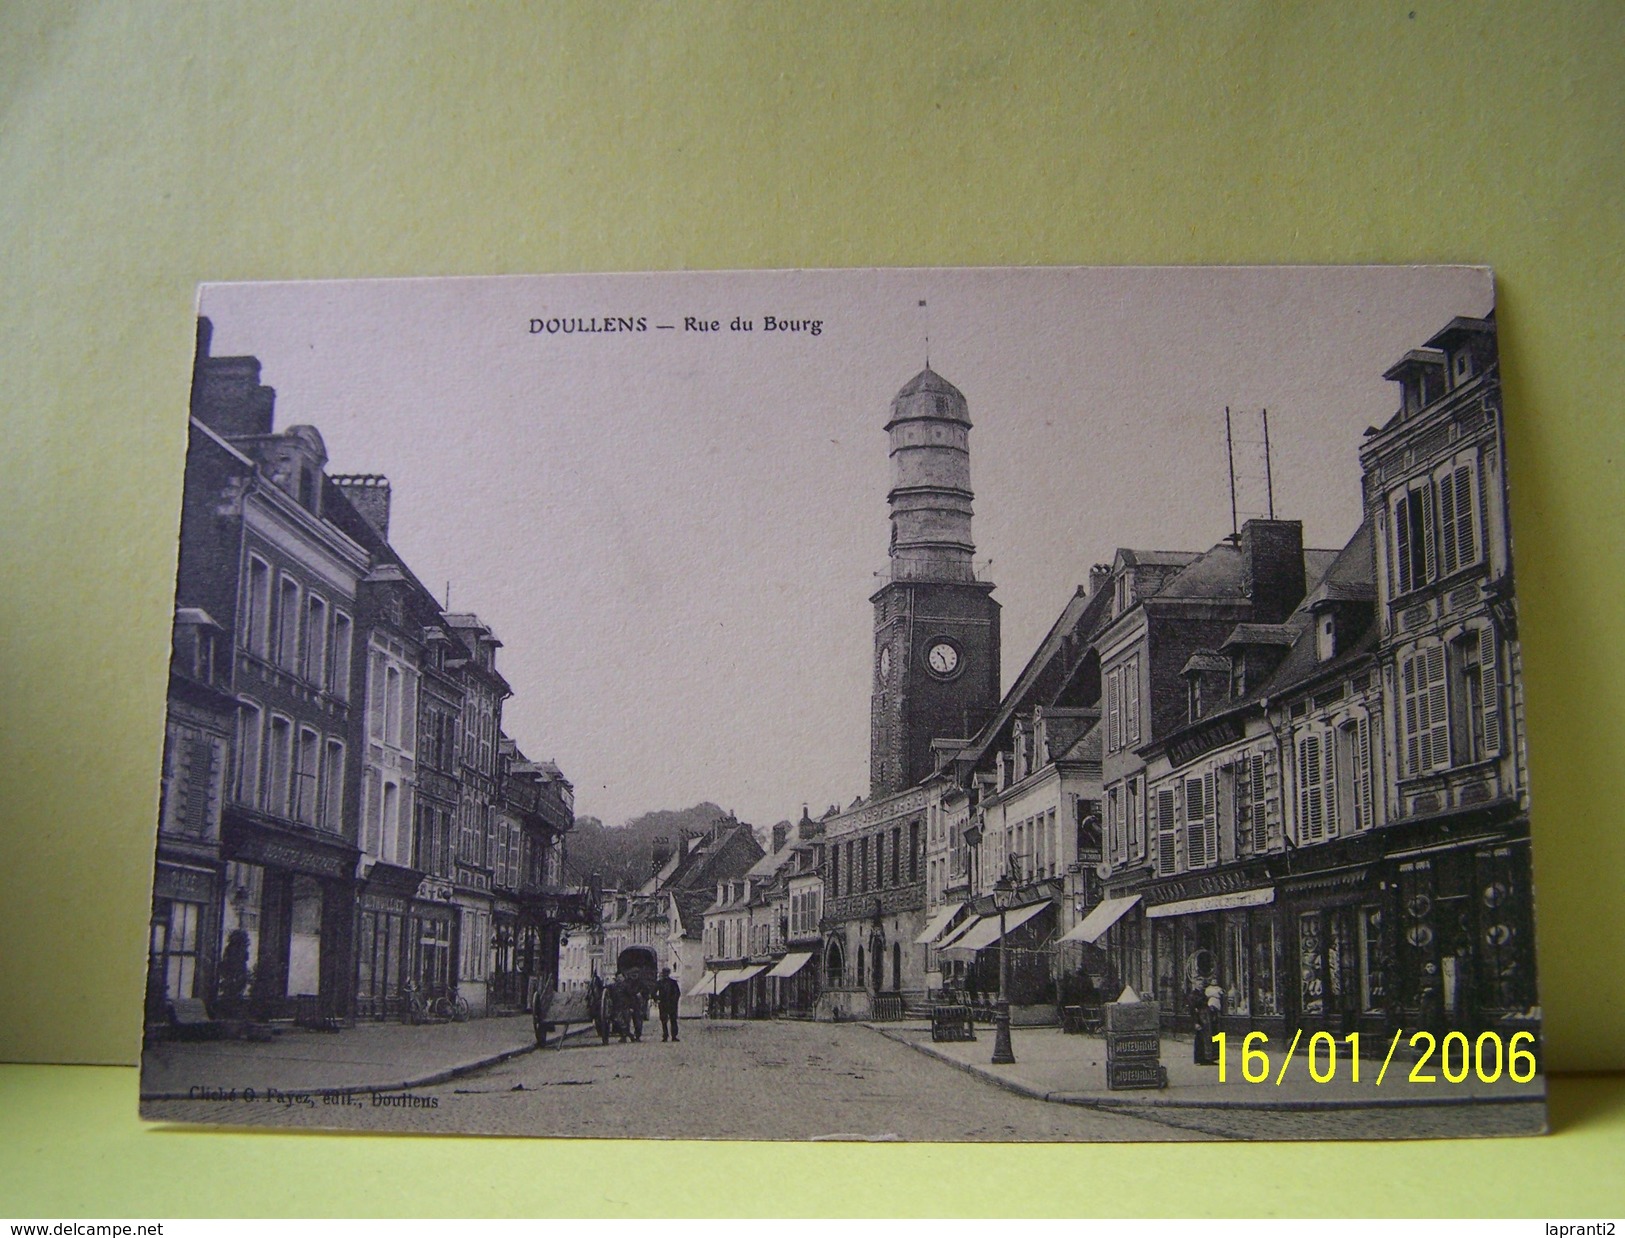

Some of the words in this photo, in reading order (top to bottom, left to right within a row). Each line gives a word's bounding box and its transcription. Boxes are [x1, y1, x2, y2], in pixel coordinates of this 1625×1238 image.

[529, 316, 647, 334] DOULLENS
[684, 316, 720, 333] Rue
[730, 316, 753, 333] du
[764, 315, 824, 336] Bourg
[189, 1086, 237, 1102] Cliché
[372, 1091, 439, 1109] Doullens
